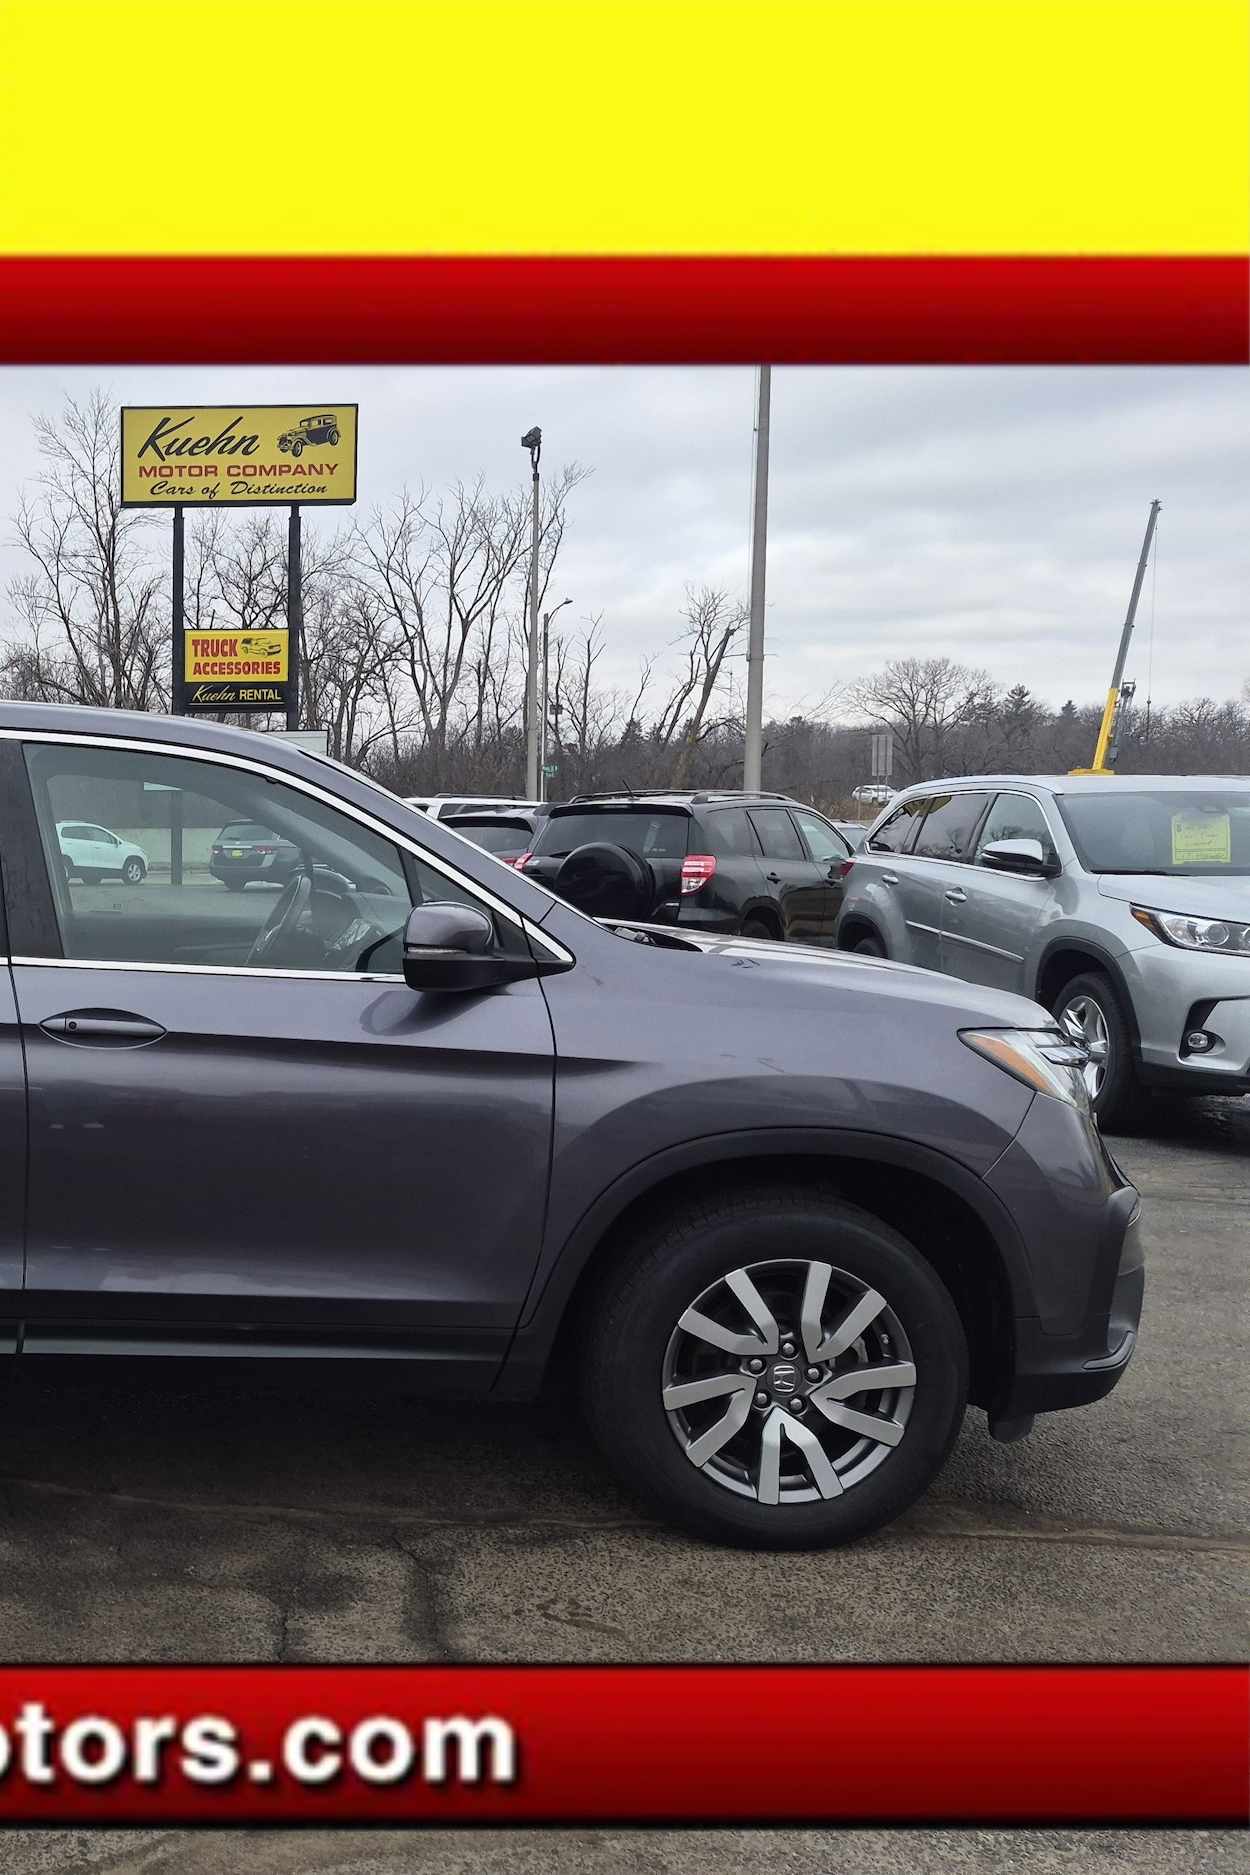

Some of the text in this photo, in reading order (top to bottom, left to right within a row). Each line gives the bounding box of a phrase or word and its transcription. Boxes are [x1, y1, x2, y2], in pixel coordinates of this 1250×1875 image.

[137, 416, 260, 462] Kuehn
[139, 463, 339, 478] MOTOR COMPANY
[150, 480, 328, 500] Cars of Distinction
[192, 639, 238, 657] TRUCK
[193, 661, 281, 675] ACCESSORIES
[192, 685, 282, 703] Kuehn RENTAL
